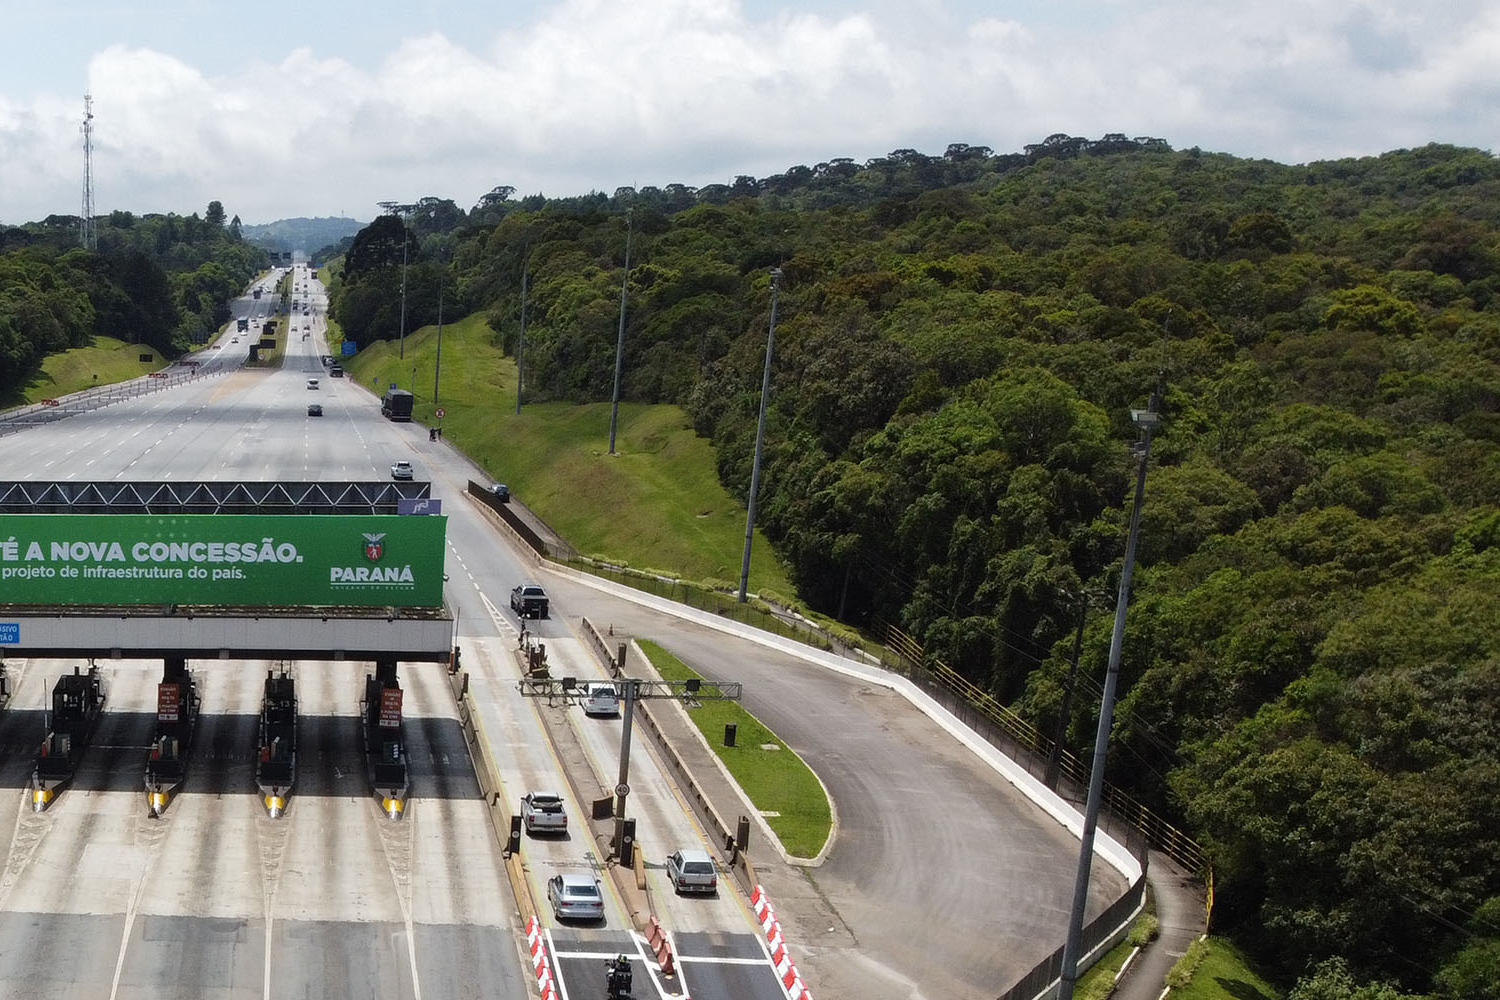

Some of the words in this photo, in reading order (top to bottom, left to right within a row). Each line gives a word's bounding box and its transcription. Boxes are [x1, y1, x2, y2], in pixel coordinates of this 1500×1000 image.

[24, 541, 45, 561] A
[51, 541, 126, 562] NOVA
[131, 537, 304, 563] CONCESSÃO.
[2, 564, 56, 580] projeto
[59, 564, 79, 578] de
[83, 564, 183, 579] infraestrutura
[187, 565, 208, 579] do
[212, 566, 247, 581] país.
[330, 564, 415, 582] PARANÁ
